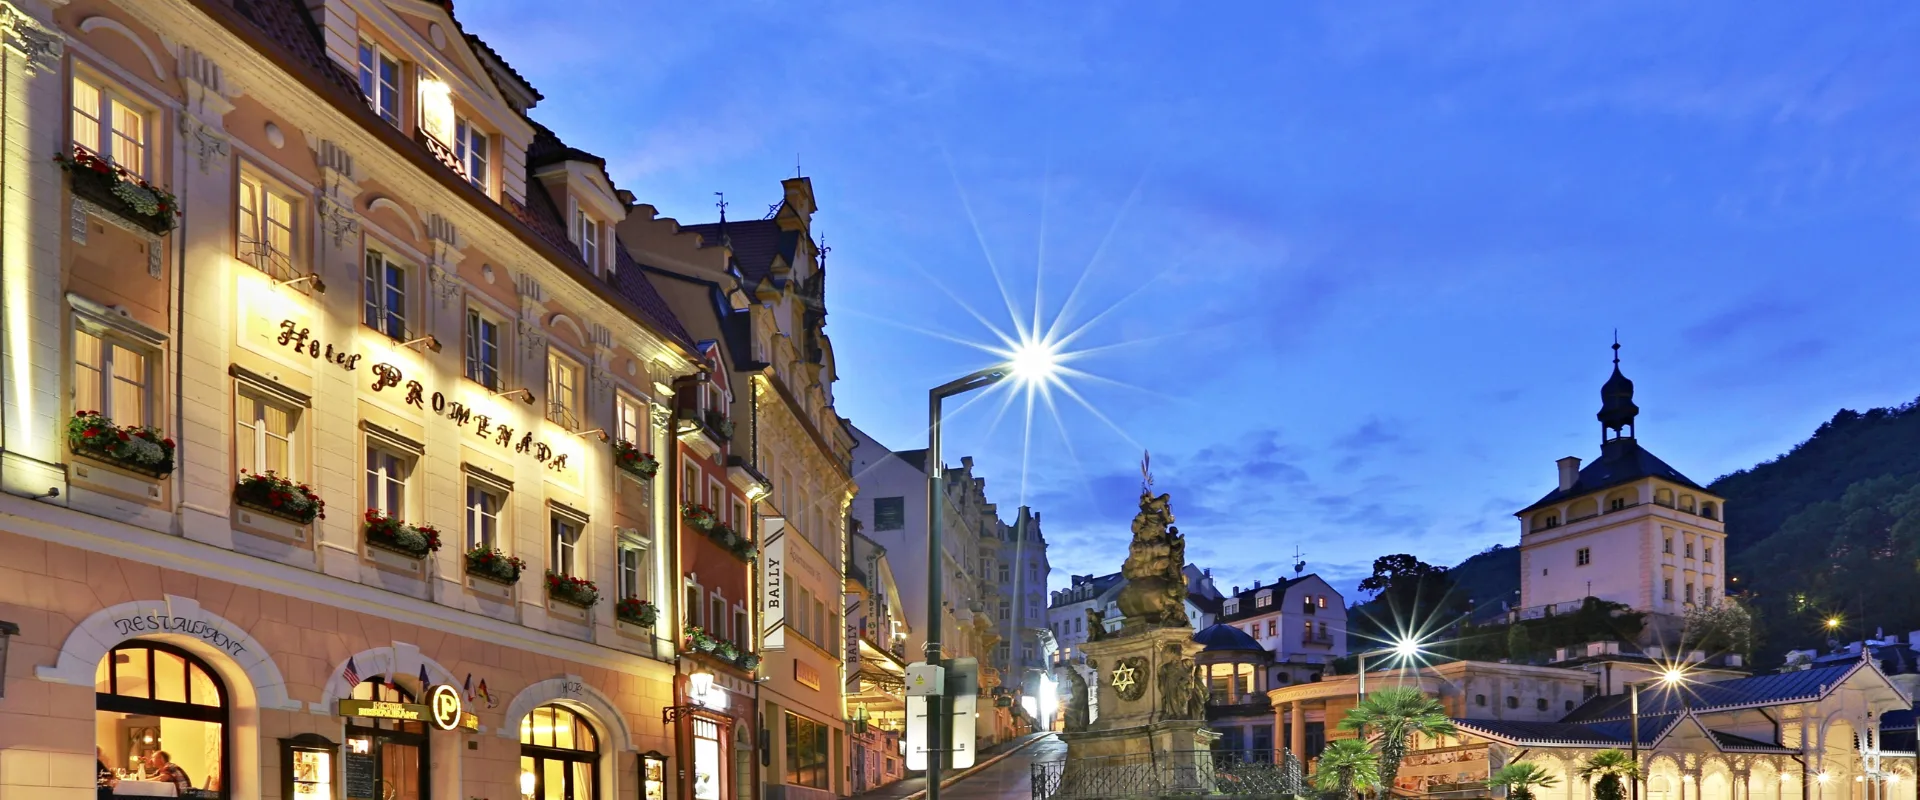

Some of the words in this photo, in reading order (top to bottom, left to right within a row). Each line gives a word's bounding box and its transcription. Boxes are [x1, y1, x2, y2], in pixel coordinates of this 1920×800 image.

[277, 319, 362, 372] Hotel
[769, 558, 780, 608] BALLY
[848, 624, 857, 663] BALLY
[358, 707, 419, 719] RESTAURANT
[373, 702, 404, 711] HOTEL
[439, 694, 457, 721] P
